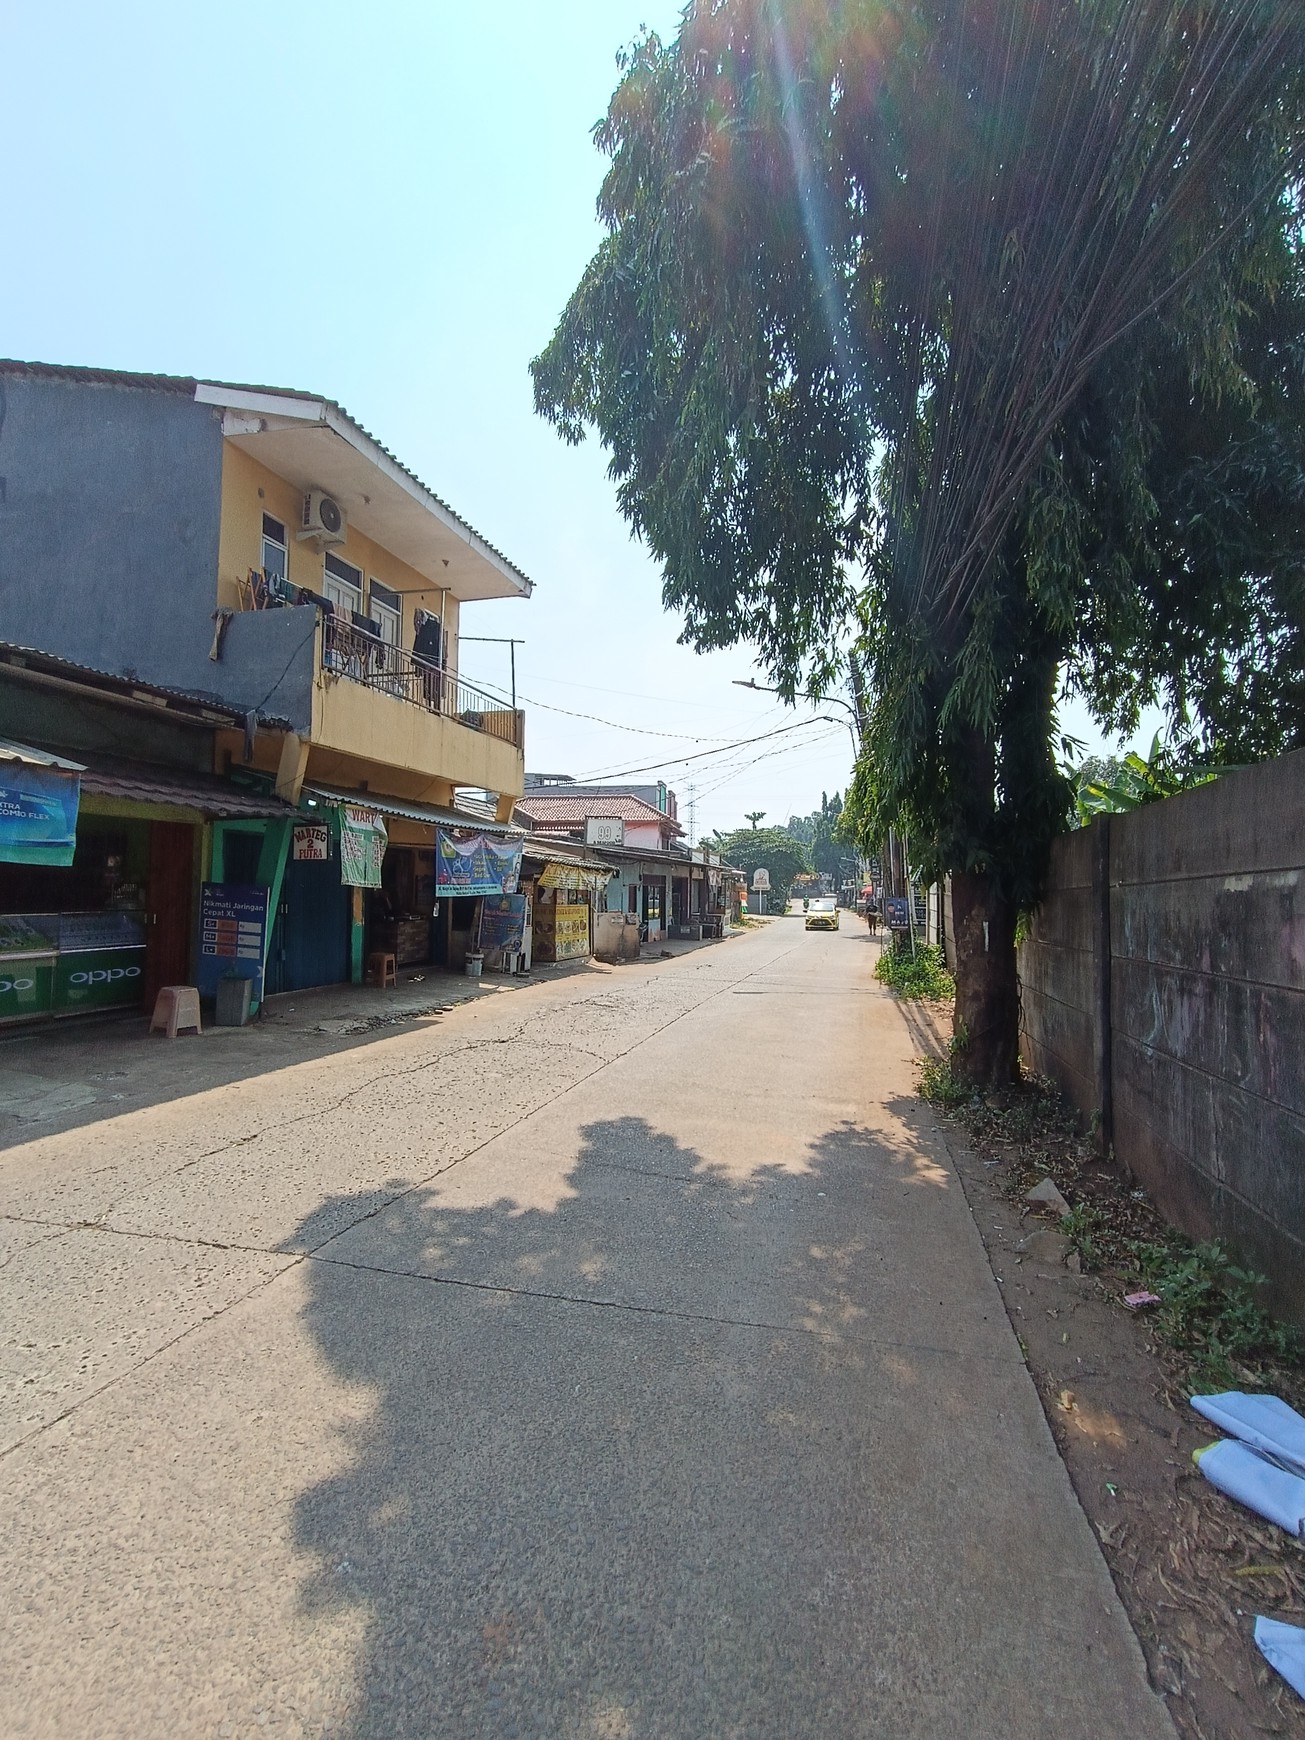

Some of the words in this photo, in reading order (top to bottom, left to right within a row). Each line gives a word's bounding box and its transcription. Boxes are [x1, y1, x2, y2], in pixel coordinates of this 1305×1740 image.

[28, 812, 49, 820] FLEX
[295, 828, 327, 843] WARTEG
[307, 838, 314, 848] 2
[299, 848, 322, 859] PUTRA
[203, 900, 231, 909] Nikmati
[232, 902, 264, 912] Jaringan
[203, 908, 224, 917] Cepat
[226, 910, 236, 918] XL
[70, 966, 141, 985] oppo
